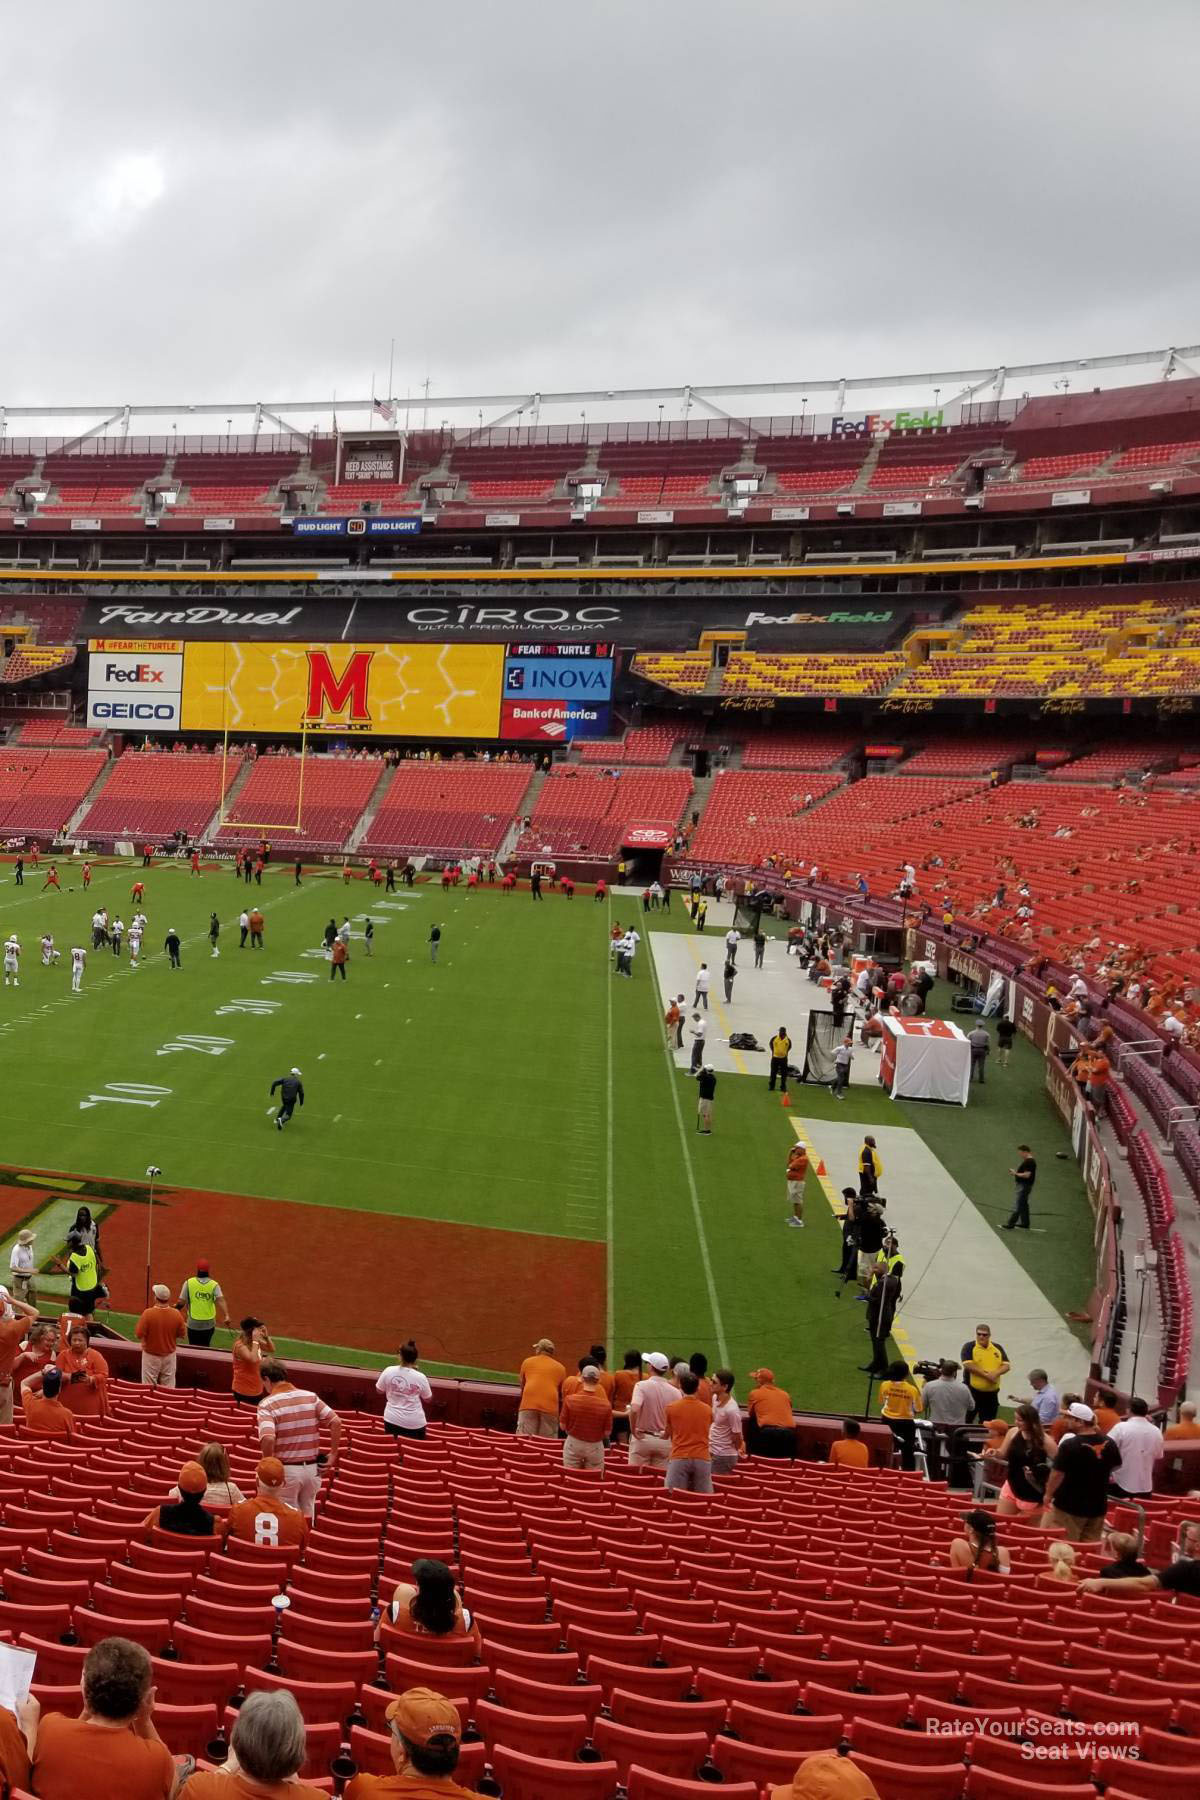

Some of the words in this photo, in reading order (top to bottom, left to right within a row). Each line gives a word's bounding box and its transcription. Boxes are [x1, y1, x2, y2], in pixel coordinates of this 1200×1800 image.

[832, 410, 943, 434] FedExField
[345, 461, 360, 471] NEED
[360, 461, 393, 471] ASSISTANCE
[298, 523, 315, 531] BUD
[316, 523, 341, 531] LIGHT
[350, 522, 363, 532] 40
[371, 522, 388, 531] BUD
[389, 522, 416, 530] LIGHT
[98, 606, 303, 625] FanDuel
[407, 604, 621, 624] CÎROC
[745, 611, 893, 627] FedExField
[108, 642, 176, 651] #FEARTHETURTLE
[512, 645, 590, 656] #FEARTHETURTLE
[105, 664, 164, 683] FedEx
[531, 670, 607, 689] INOVA
[301, 651, 375, 720] M
[92, 702, 174, 720] GEICO
[513, 708, 540, 719] Bank
[553, 709, 597, 720] America
[628, 835, 668, 843] TOYOTA
[224, 998, 283, 1015] 30
[162, 1033, 236, 1056] 20
[89, 1082, 173, 1107] 10
[255, 1512, 279, 1547] 8
